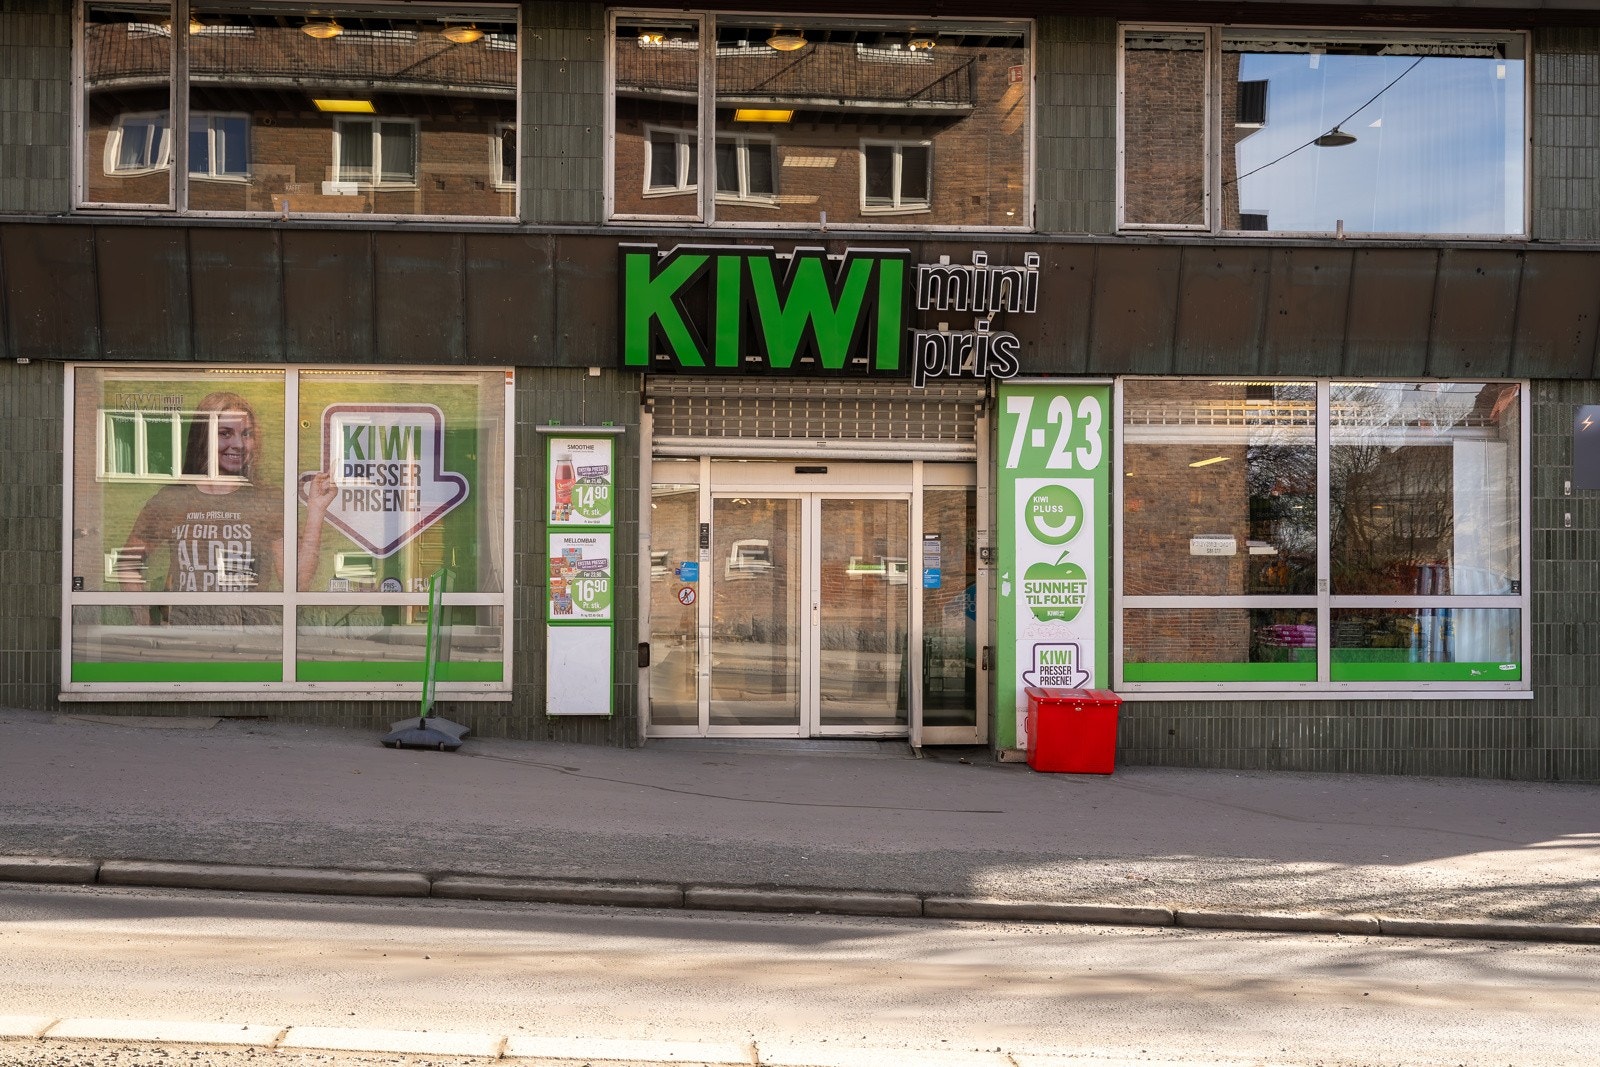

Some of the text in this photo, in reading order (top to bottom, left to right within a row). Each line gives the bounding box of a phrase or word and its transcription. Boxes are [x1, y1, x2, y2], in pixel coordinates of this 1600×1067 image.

[622, 250, 1040, 371] KIWI mini
[913, 317, 1021, 389] pris
[115, 393, 183, 413] KIWI mini
[343, 425, 422, 461] KIWI
[1005, 395, 1103, 470] 7-23
[343, 463, 422, 487] PRESSER
[341, 489, 421, 512] PRISENE!
[1033, 505, 1064, 513] PLUSS
[192, 524, 218, 539] GIR
[222, 524, 252, 539] OSS
[178, 539, 252, 571] ALDRI
[179, 566, 197, 592] PÅ
[1024, 582, 1087, 594] SUNNHET
[1026, 594, 1086, 605] TIL FOLKET
[1039, 650, 1072, 665] KIWI
[1039, 665, 1072, 676] PRESSER
[1039, 676, 1072, 686] PRISENE!
